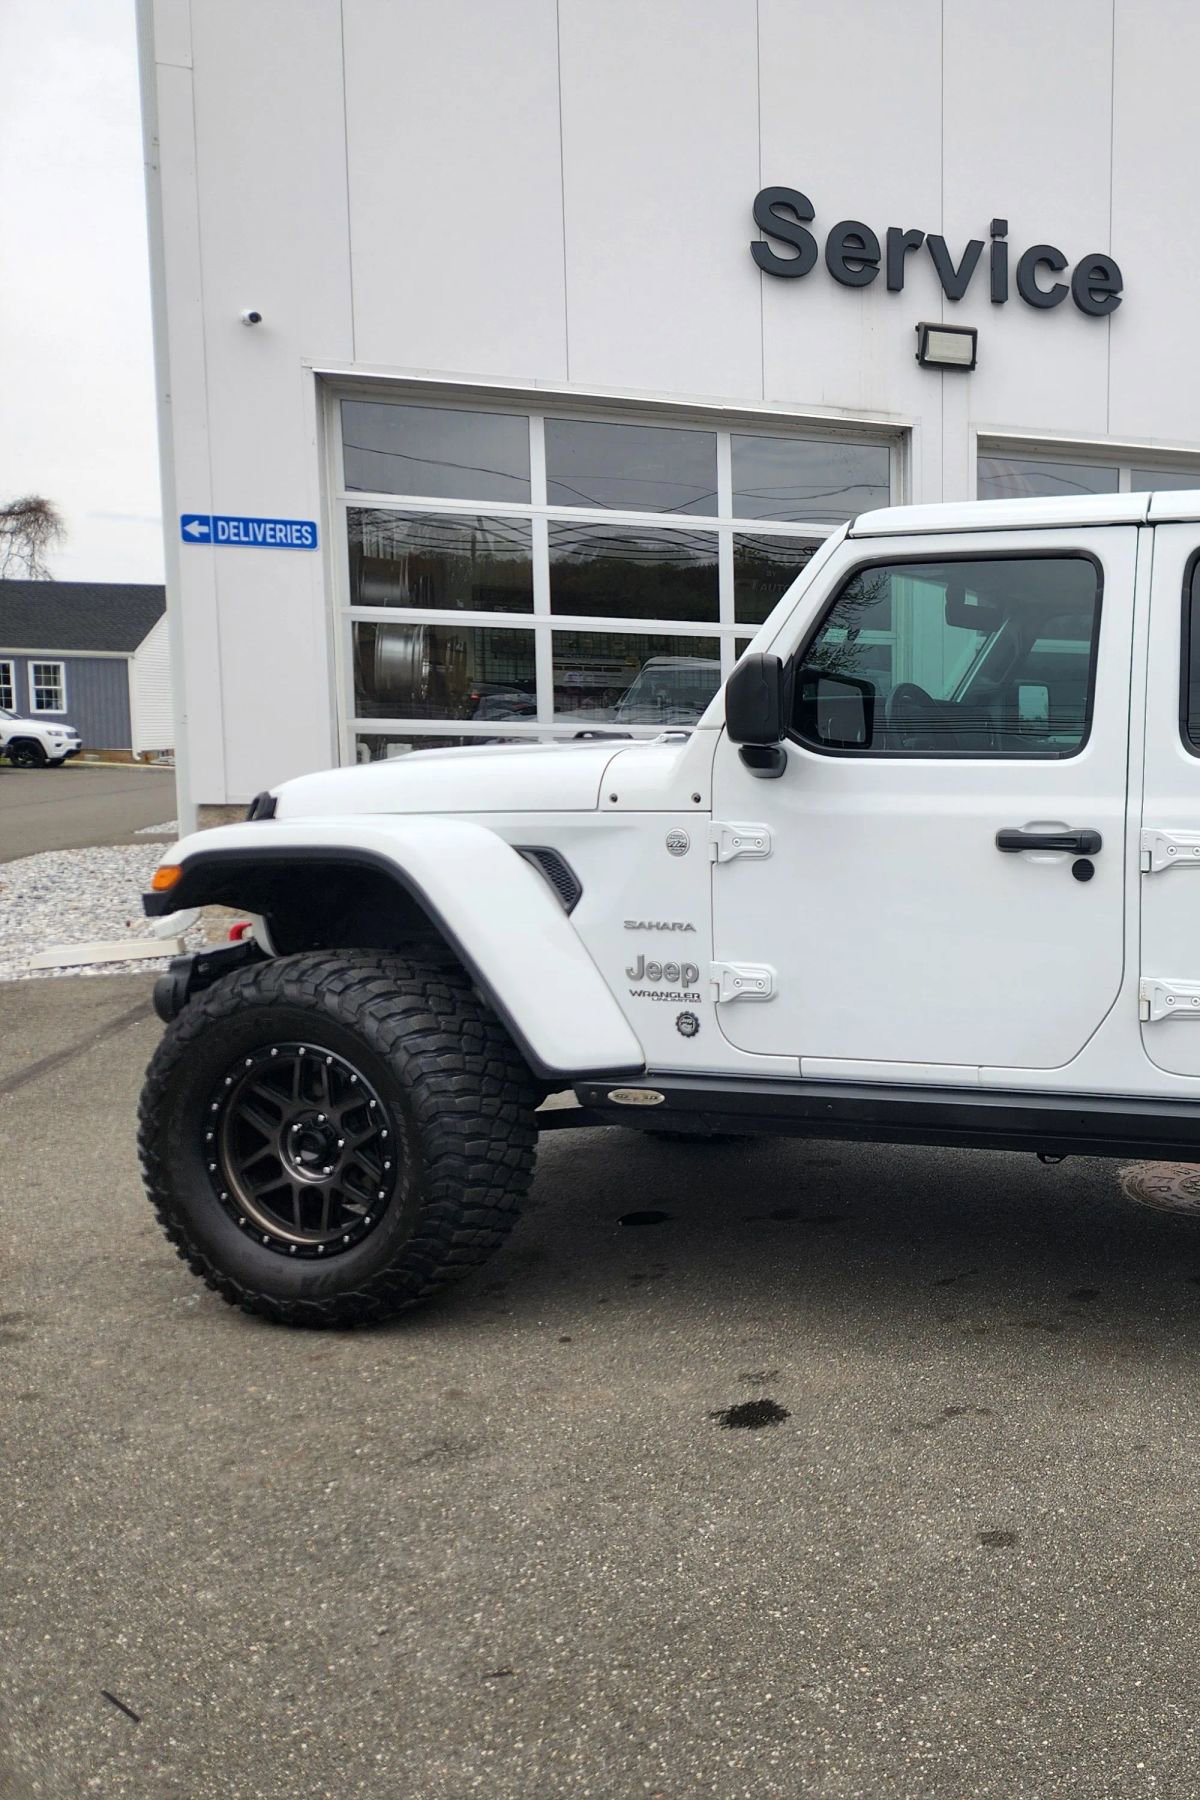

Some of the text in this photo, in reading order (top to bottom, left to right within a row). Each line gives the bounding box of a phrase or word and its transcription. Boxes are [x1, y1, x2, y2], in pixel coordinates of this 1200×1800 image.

[750, 186, 1124, 317] Service
[217, 520, 312, 545] DELIVERIES
[623, 920, 697, 932] SAHARA
[625, 954, 700, 989] Jeep
[629, 988, 701, 999] WRANGLER
